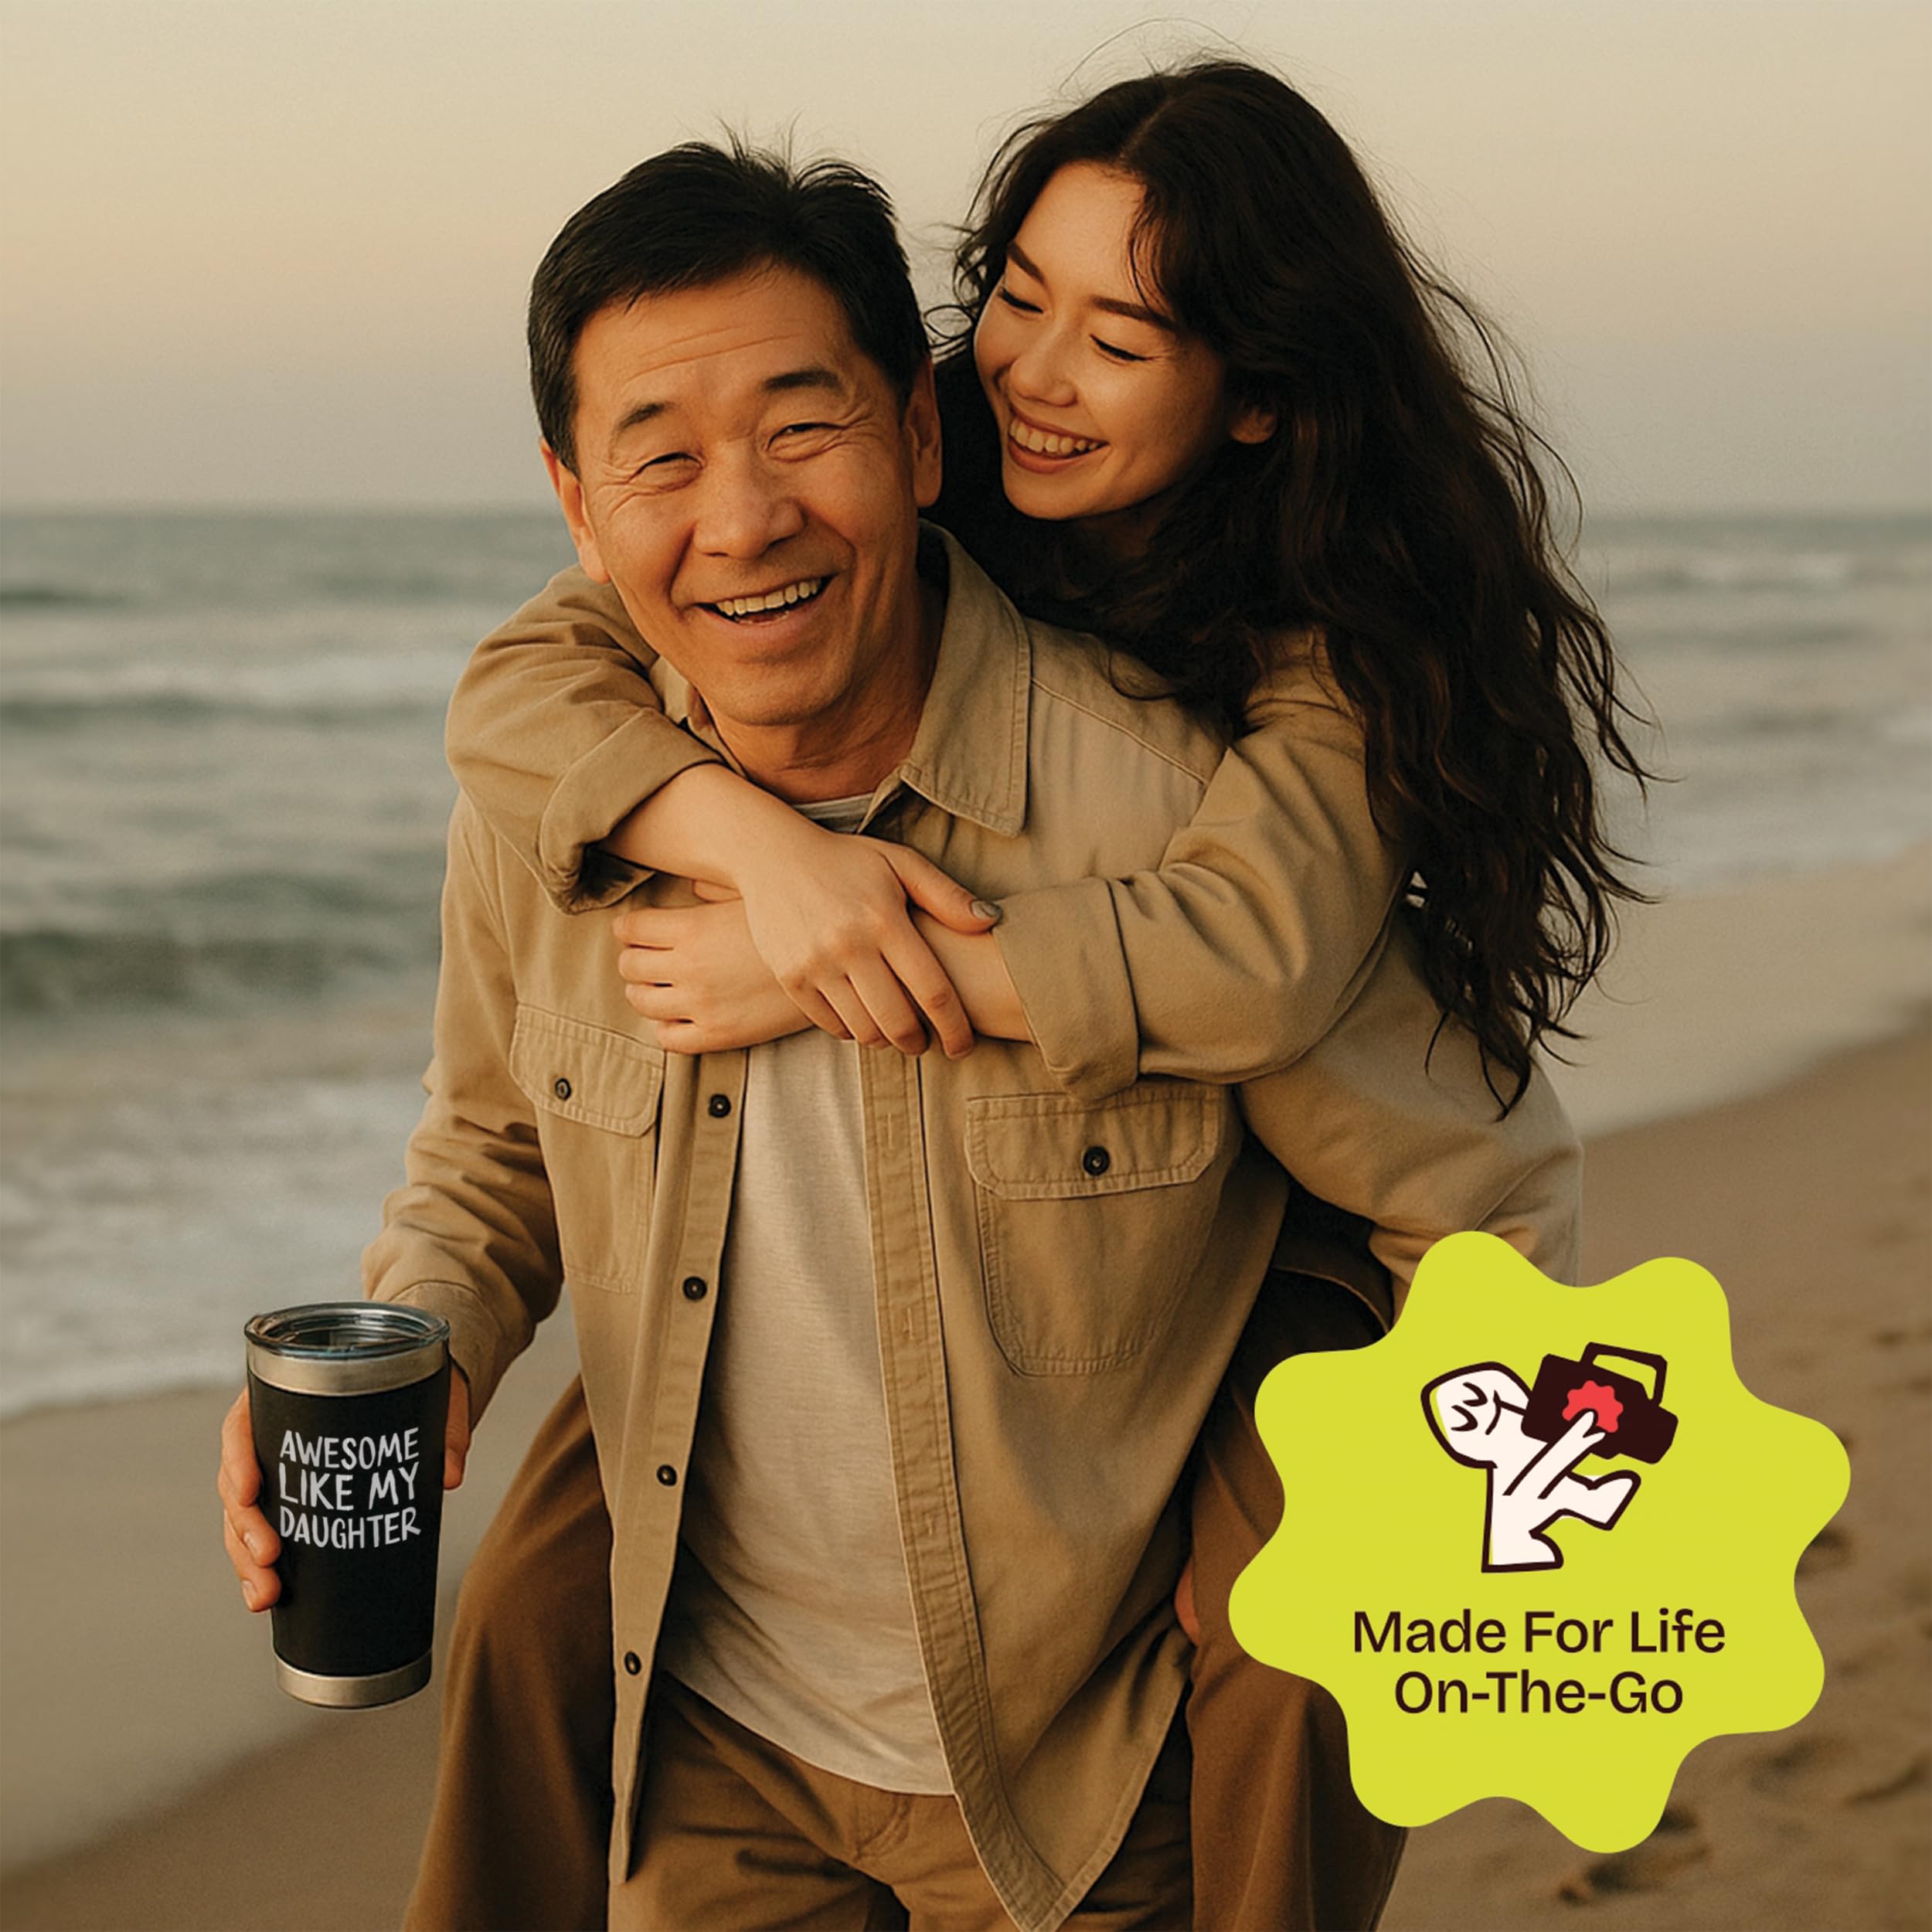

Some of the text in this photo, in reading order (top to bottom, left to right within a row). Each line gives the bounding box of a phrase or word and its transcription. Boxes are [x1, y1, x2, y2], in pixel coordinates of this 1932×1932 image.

[280, 1427, 419, 1471] AWESOME
[278, 1461, 419, 1512] LIKE MY
[280, 1505, 421, 1549] DAUGHTER
